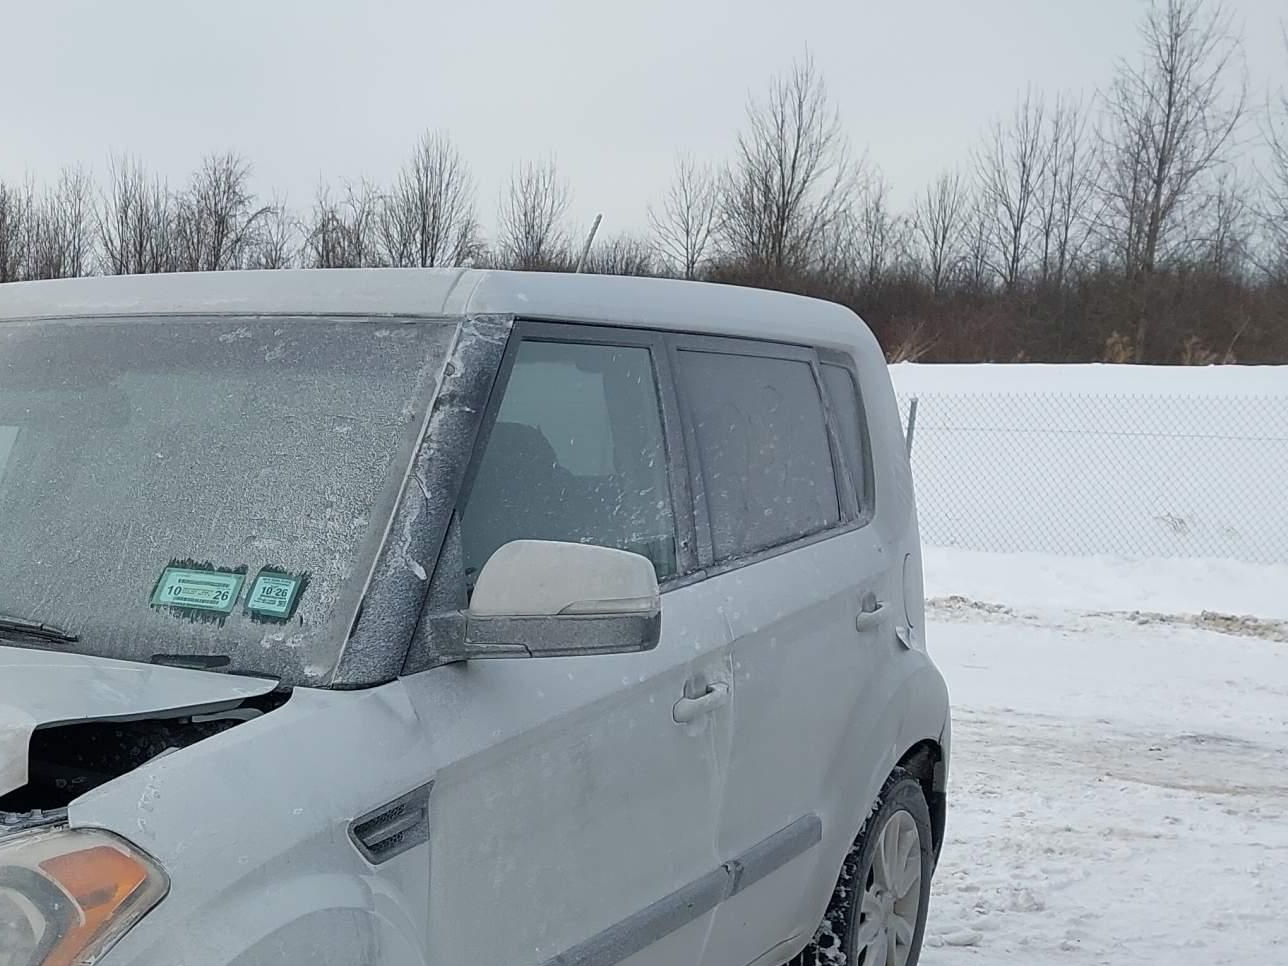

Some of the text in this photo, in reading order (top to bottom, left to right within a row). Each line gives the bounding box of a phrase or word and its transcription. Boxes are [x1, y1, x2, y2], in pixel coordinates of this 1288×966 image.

[167, 585, 182, 596] 10
[213, 590, 229, 601] 26
[261, 586, 288, 597] 10-26
